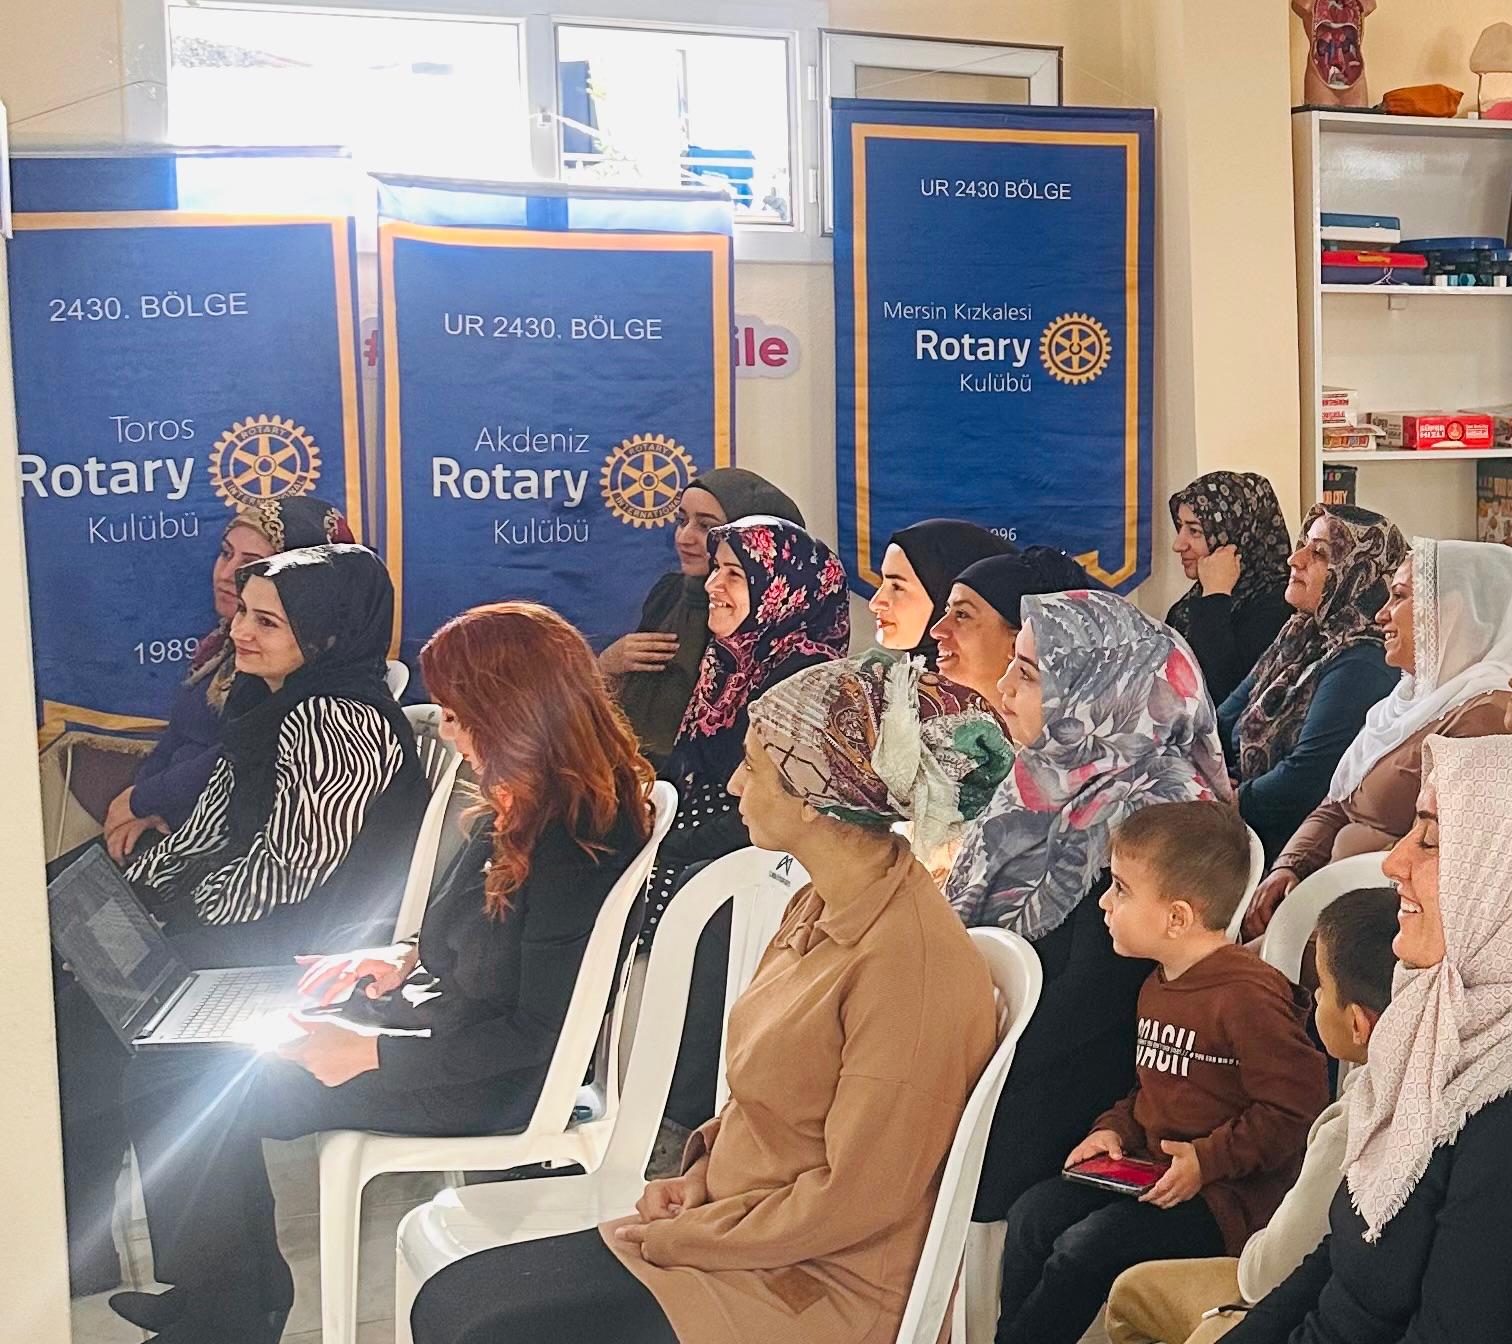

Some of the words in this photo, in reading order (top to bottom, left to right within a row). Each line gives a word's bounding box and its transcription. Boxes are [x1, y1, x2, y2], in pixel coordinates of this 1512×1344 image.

[920, 179, 949, 197] UR
[955, 180, 999, 198] 2430
[1005, 179, 1072, 200] BÖLGE
[49, 297, 130, 322] 2430.
[140, 291, 249, 319] BÖLGE
[884, 302, 947, 320] Mersin
[954, 302, 1032, 321] Kızkalesi
[444, 313, 484, 336] UR
[493, 316, 562, 339] 2430.
[571, 314, 663, 340] BÖLGE
[916, 329, 1031, 368] Rotary
[960, 372, 1032, 392] Kulübü
[109, 415, 195, 443] Toros
[240, 426, 287, 439] ROTARY
[474, 425, 590, 453] Akdeniz
[629, 443, 669, 455] ROTARY
[18, 454, 195, 500] Rotary
[432, 457, 589, 508] Rotary
[89, 511, 199, 543] Kulübü
[494, 517, 589, 544] Kulübü
[134, 637, 200, 665] 1989
